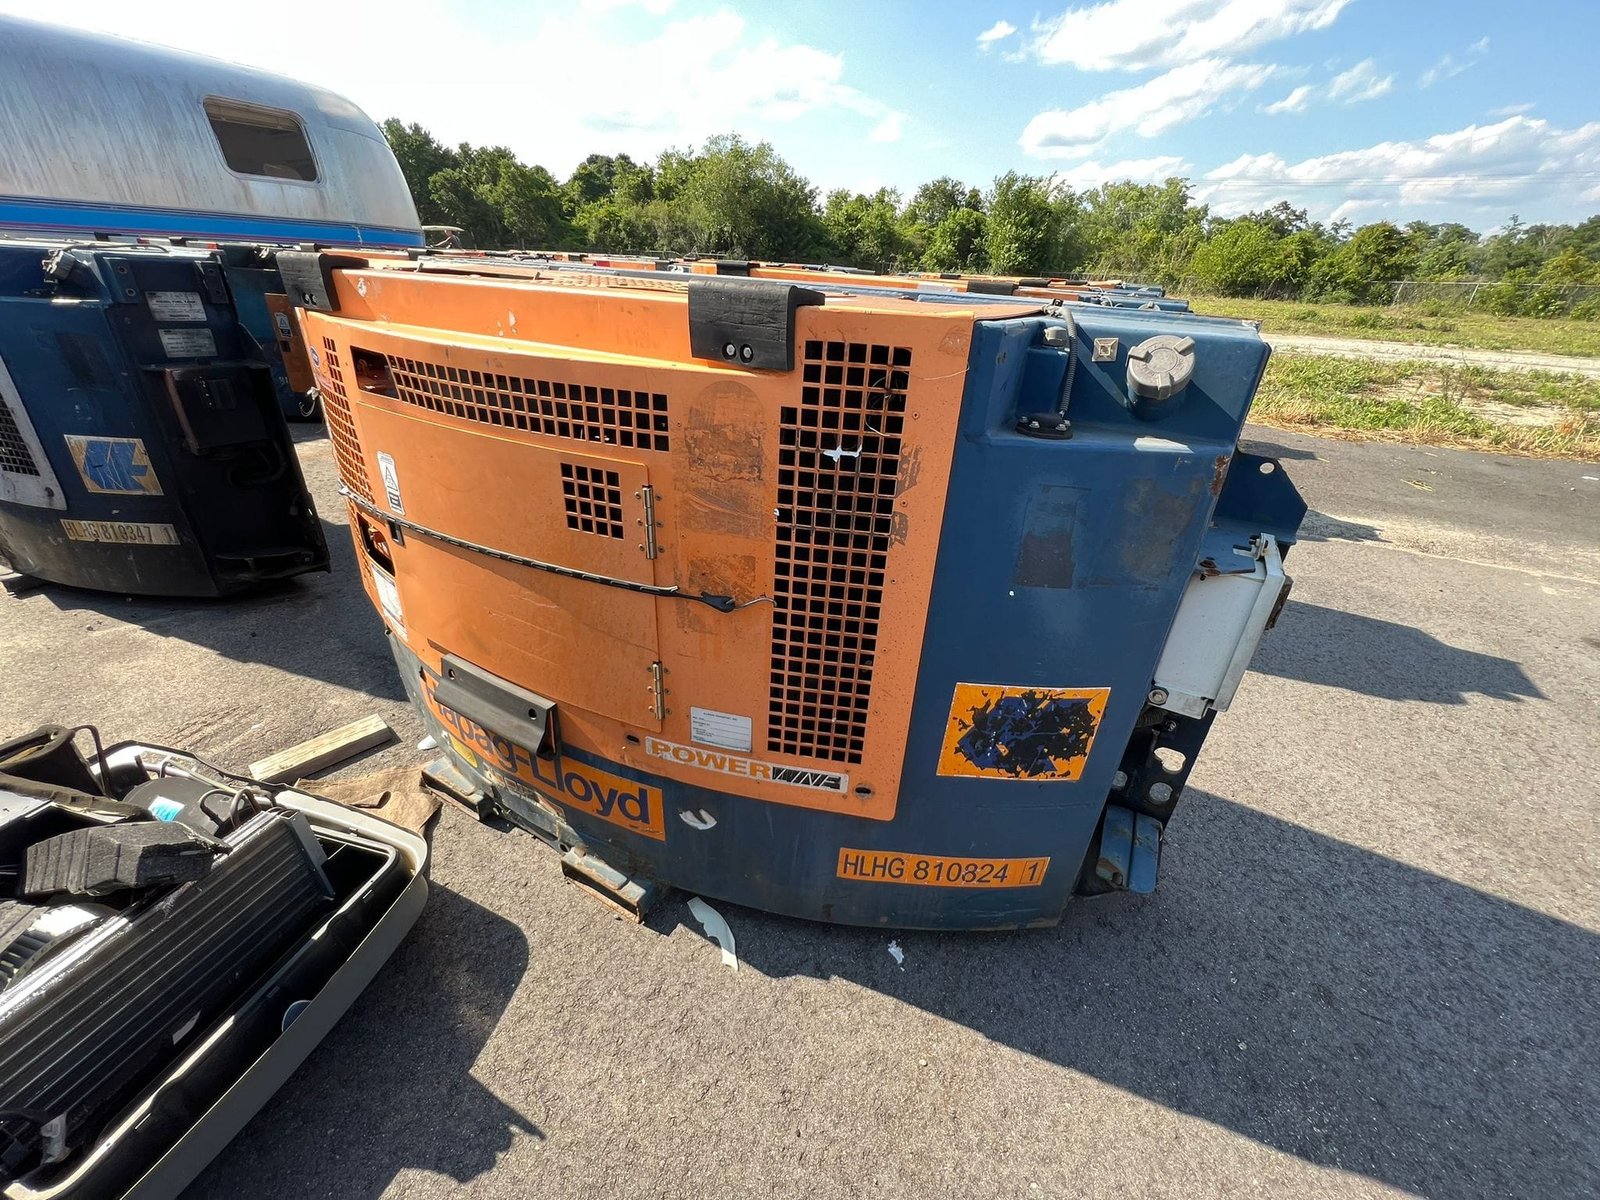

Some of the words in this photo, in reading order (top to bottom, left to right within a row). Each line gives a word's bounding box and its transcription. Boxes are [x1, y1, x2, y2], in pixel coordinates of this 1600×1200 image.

[843, 854, 905, 879] HLHG
[913, 860, 1009, 883] 810824
[1027, 862, 1041, 881] 1
